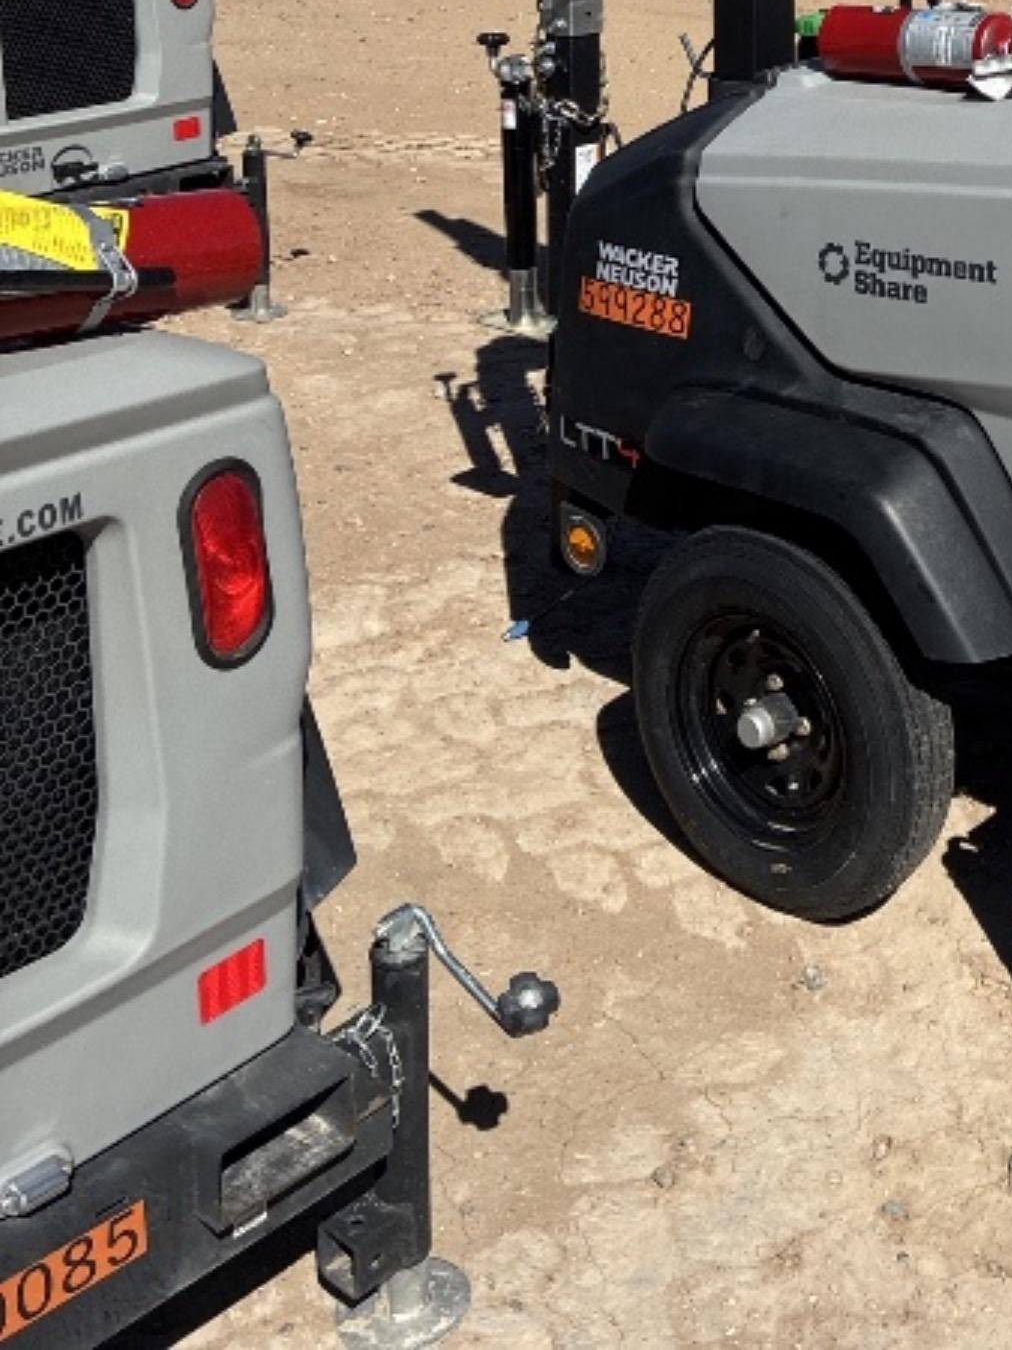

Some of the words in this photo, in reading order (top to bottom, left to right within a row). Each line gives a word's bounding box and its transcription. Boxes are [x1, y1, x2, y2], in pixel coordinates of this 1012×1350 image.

[596, 260, 679, 299] NEUSON
[598, 239, 679, 277] WACKER
[854, 239, 997, 284] Equipment
[582, 280, 687, 334] 599288
[854, 270, 928, 304] Share
[0, 492, 82, 547] .COM
[0, 1208, 138, 1333] 085
